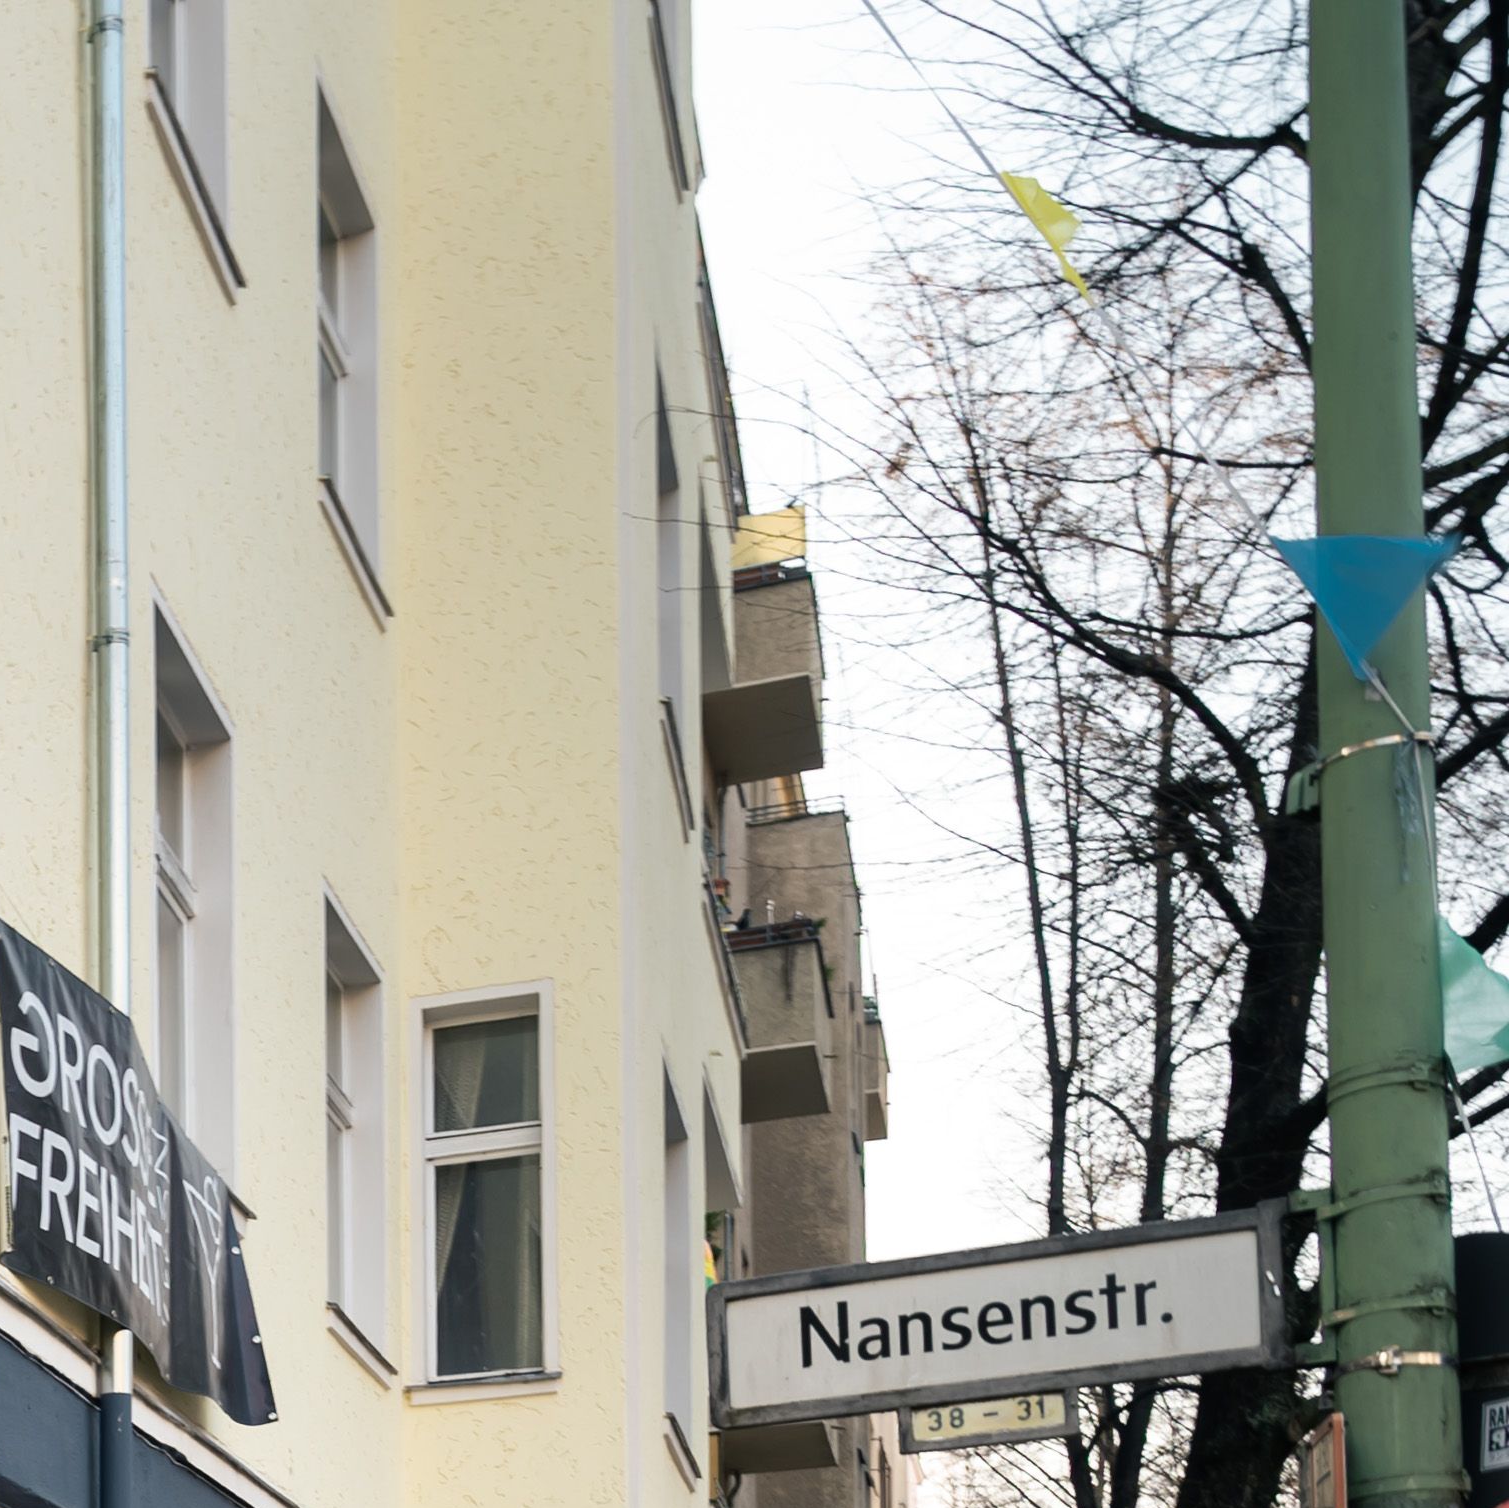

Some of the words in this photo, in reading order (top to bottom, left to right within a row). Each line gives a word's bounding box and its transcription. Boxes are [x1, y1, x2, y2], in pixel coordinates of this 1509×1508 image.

[798, 1273, 1174, 1369] Nansenstr.
[927, 1406, 965, 1432] 38
[1016, 1395, 1046, 1422] 31
